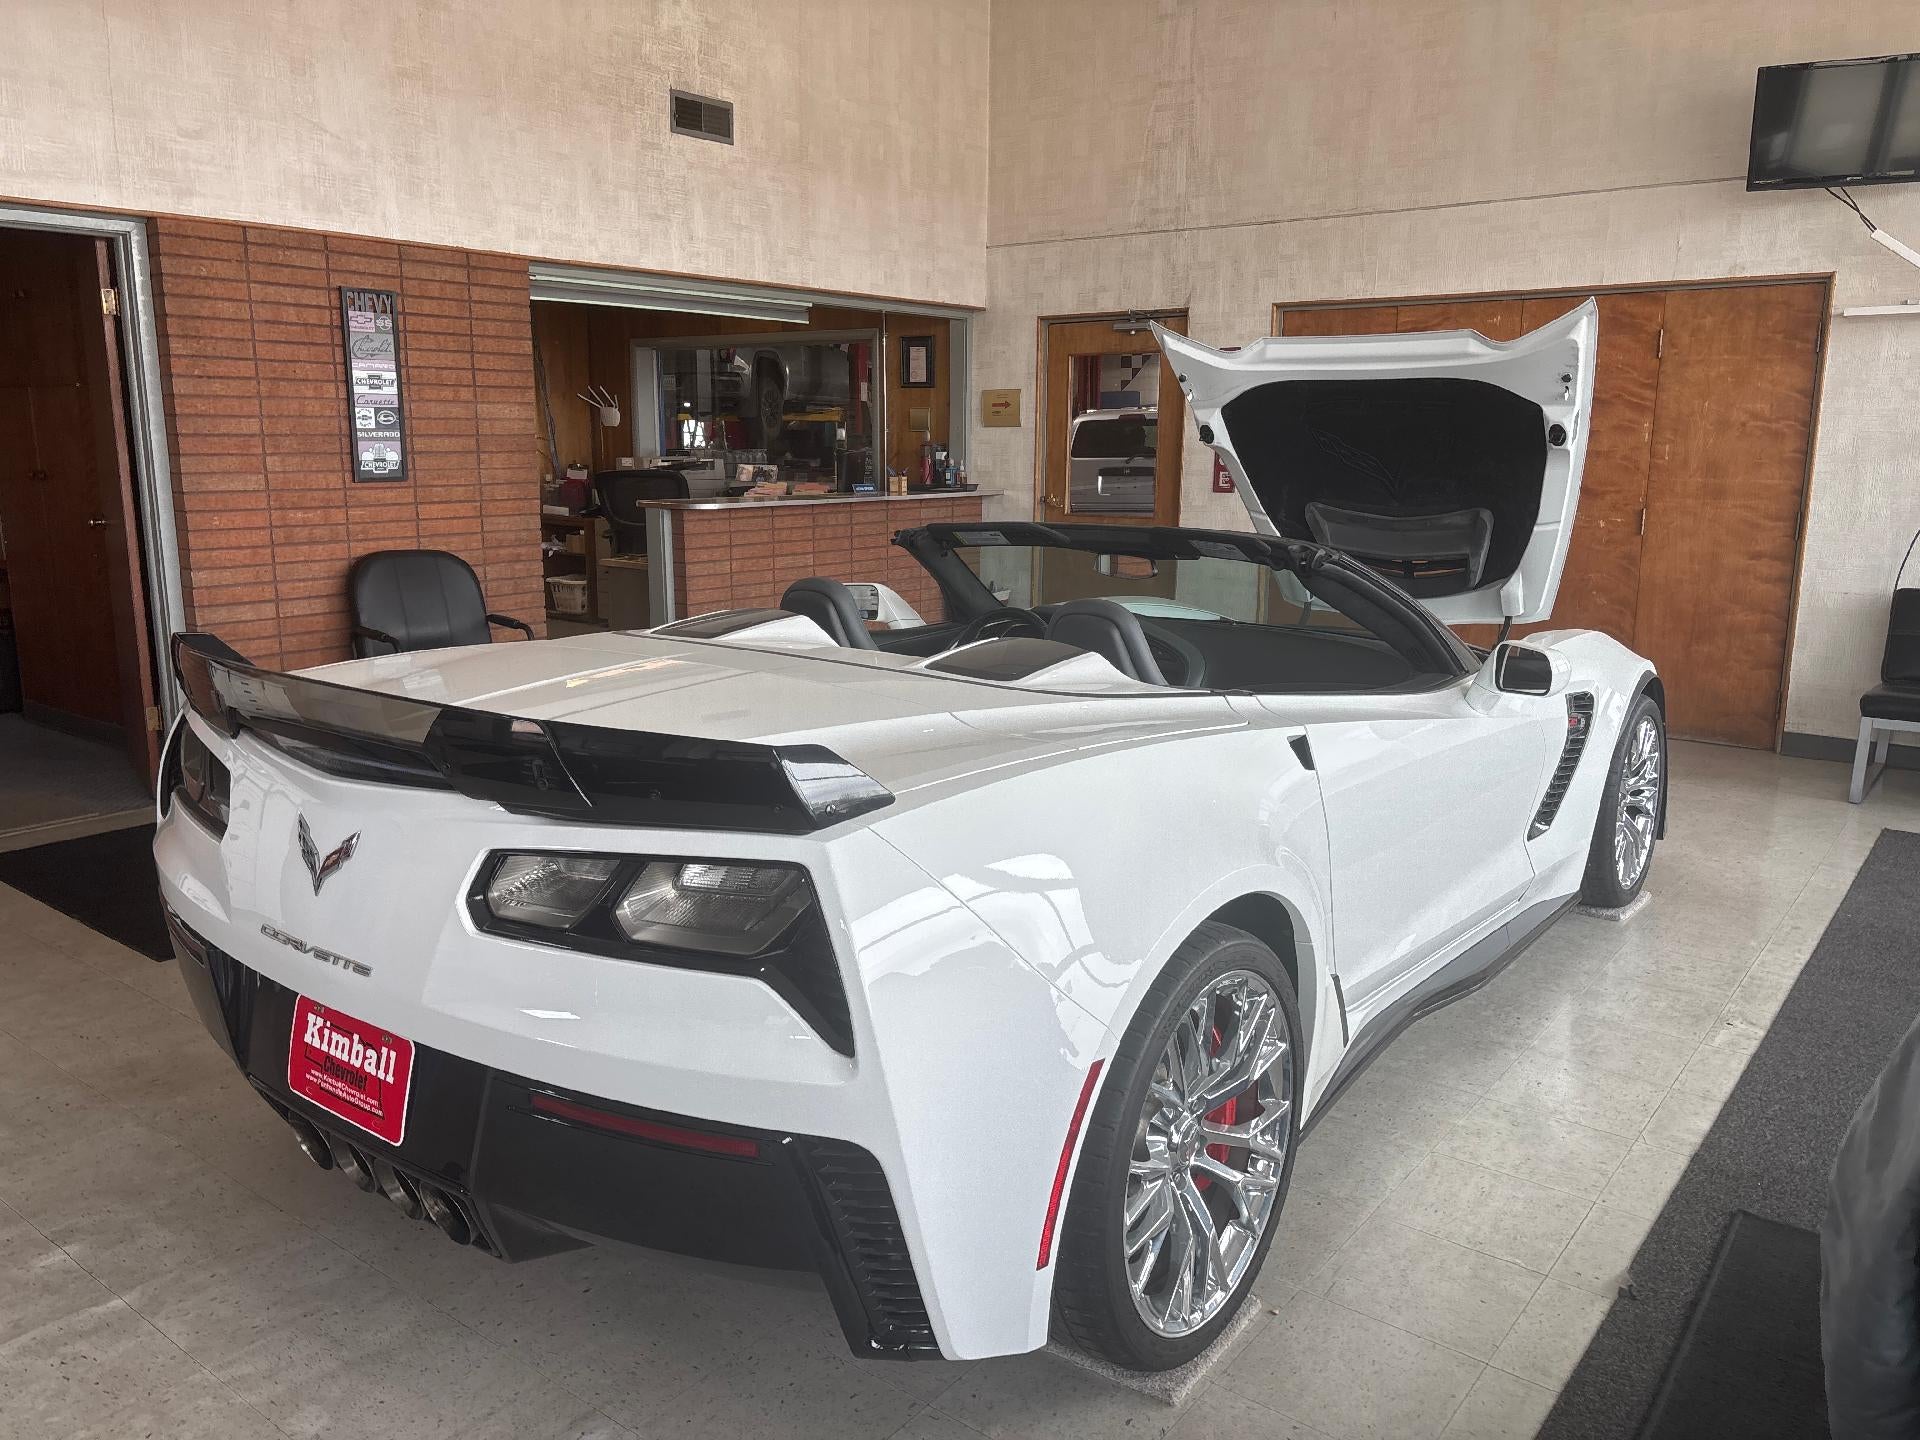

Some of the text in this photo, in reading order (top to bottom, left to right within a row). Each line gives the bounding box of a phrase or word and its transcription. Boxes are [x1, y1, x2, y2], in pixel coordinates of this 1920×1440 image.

[346, 291, 391, 314] CHEVY
[357, 378, 392, 386] CHEVROLET
[356, 395, 396, 405] Corvette
[364, 460, 397, 468] CHEVROLET
[261, 923, 372, 977] CORVETTE
[304, 1012, 397, 1084] Kimball
[323, 1056, 368, 1091] Chevrolet
